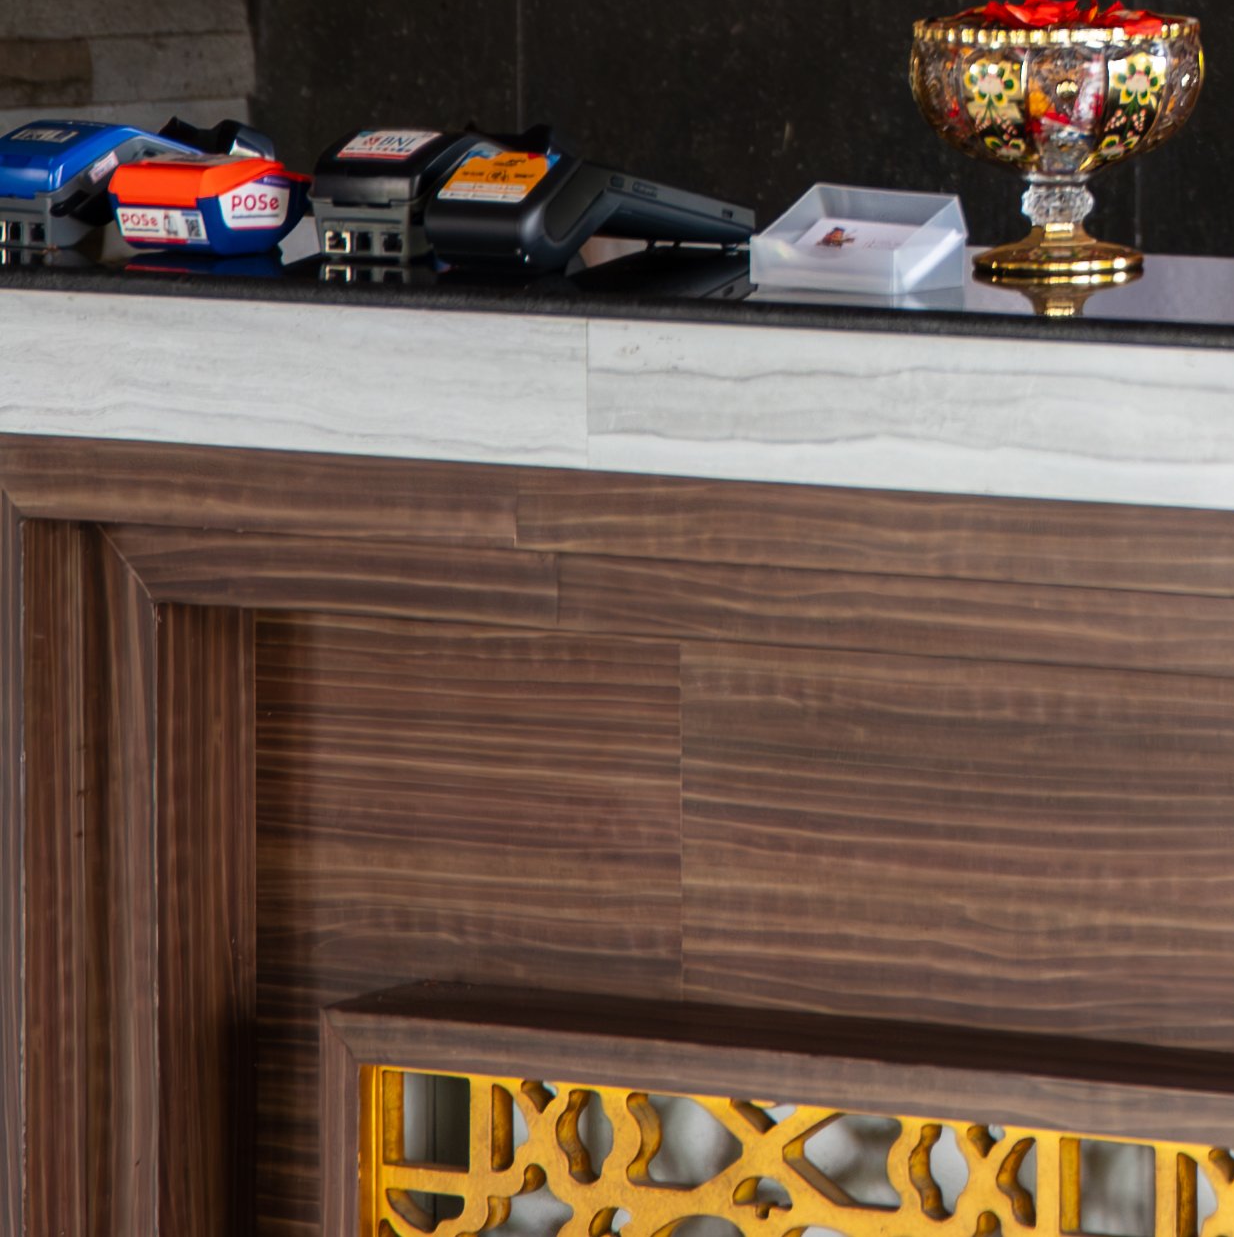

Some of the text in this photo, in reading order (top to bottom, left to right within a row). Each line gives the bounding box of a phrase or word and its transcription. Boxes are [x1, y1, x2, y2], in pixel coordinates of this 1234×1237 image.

[378, 136, 417, 148] BNI
[231, 192, 280, 212] POSe
[121, 212, 158, 227] POSe
